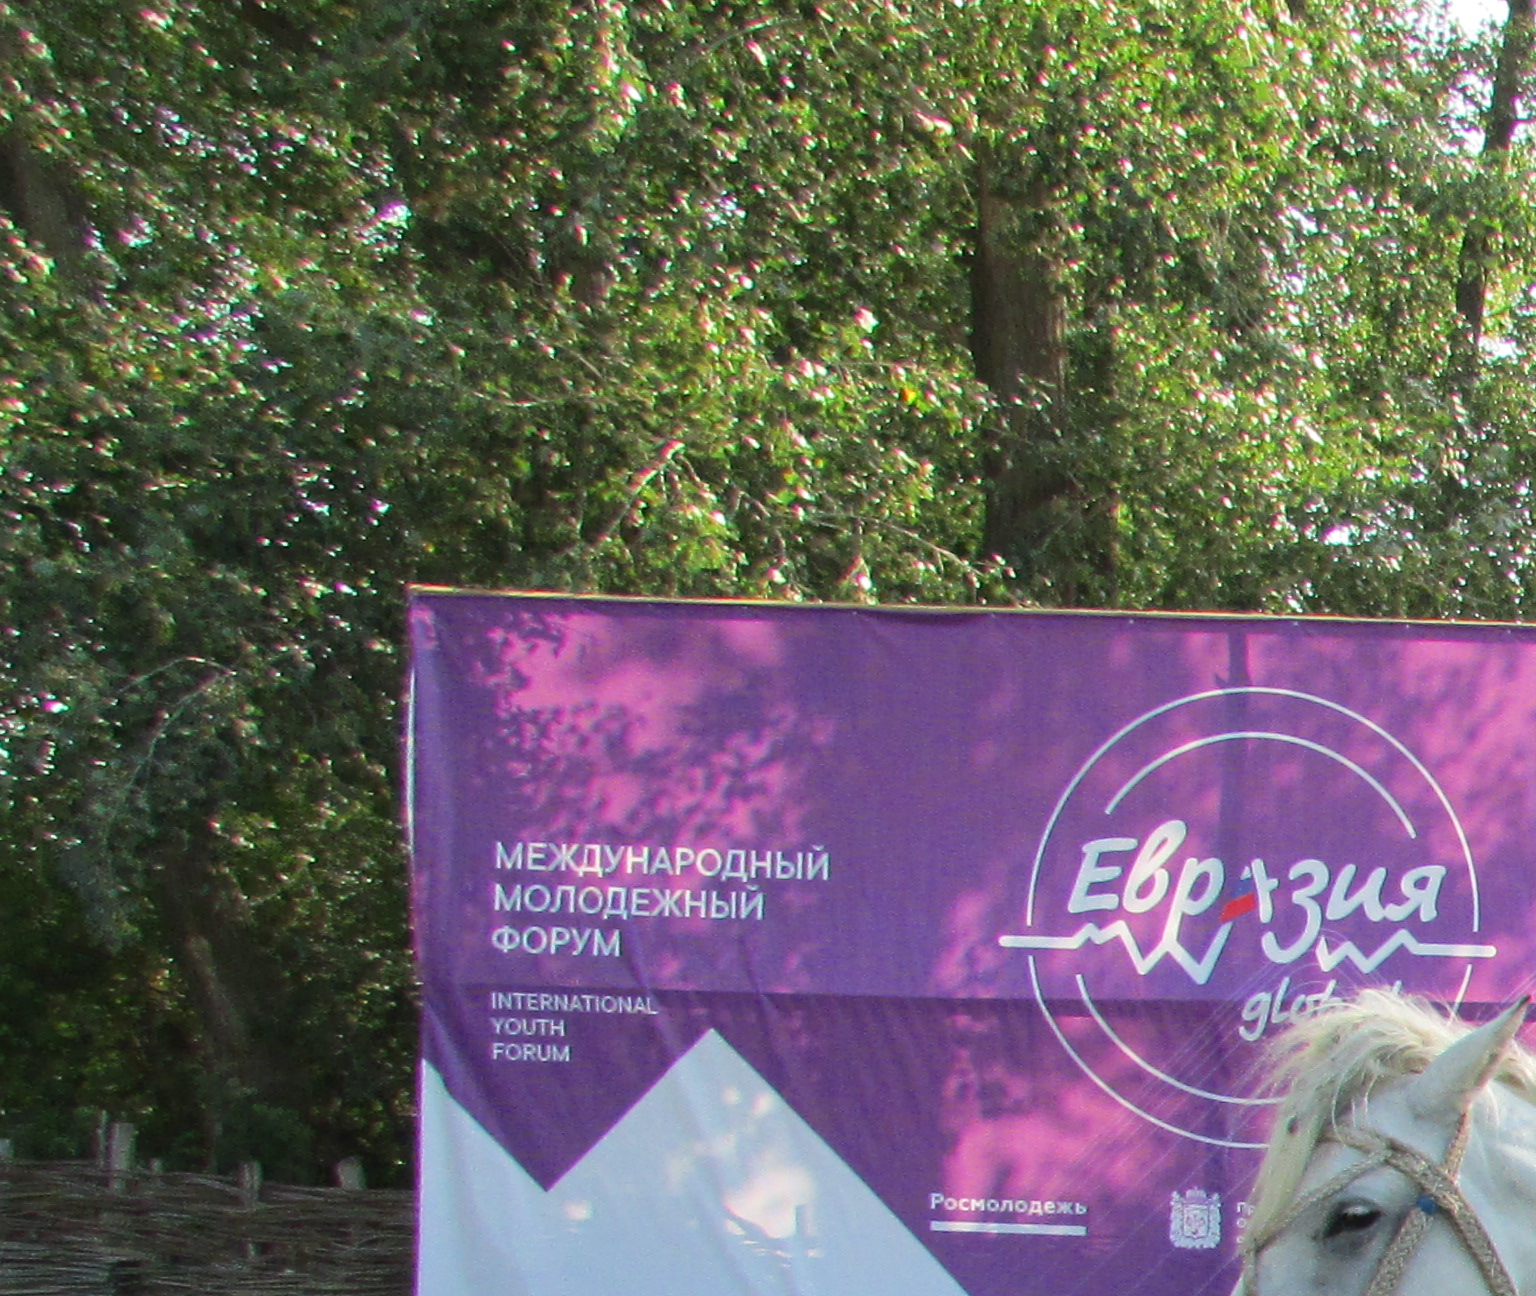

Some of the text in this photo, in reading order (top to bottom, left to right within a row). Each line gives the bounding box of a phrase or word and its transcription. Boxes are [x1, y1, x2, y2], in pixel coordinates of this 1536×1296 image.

[494, 842, 830, 882] МЕЖДУНАРОДНЫЙ
[493, 884, 764, 921] МОЛОДЕЖНЫЙ
[491, 926, 621, 957] ФОРУМ
[491, 992, 659, 1015] INTERNATIONAL
[490, 1017, 566, 1037] YOUTH
[492, 1042, 570, 1062] FORUM
[930, 1192, 1088, 1217] Росмолодежь
